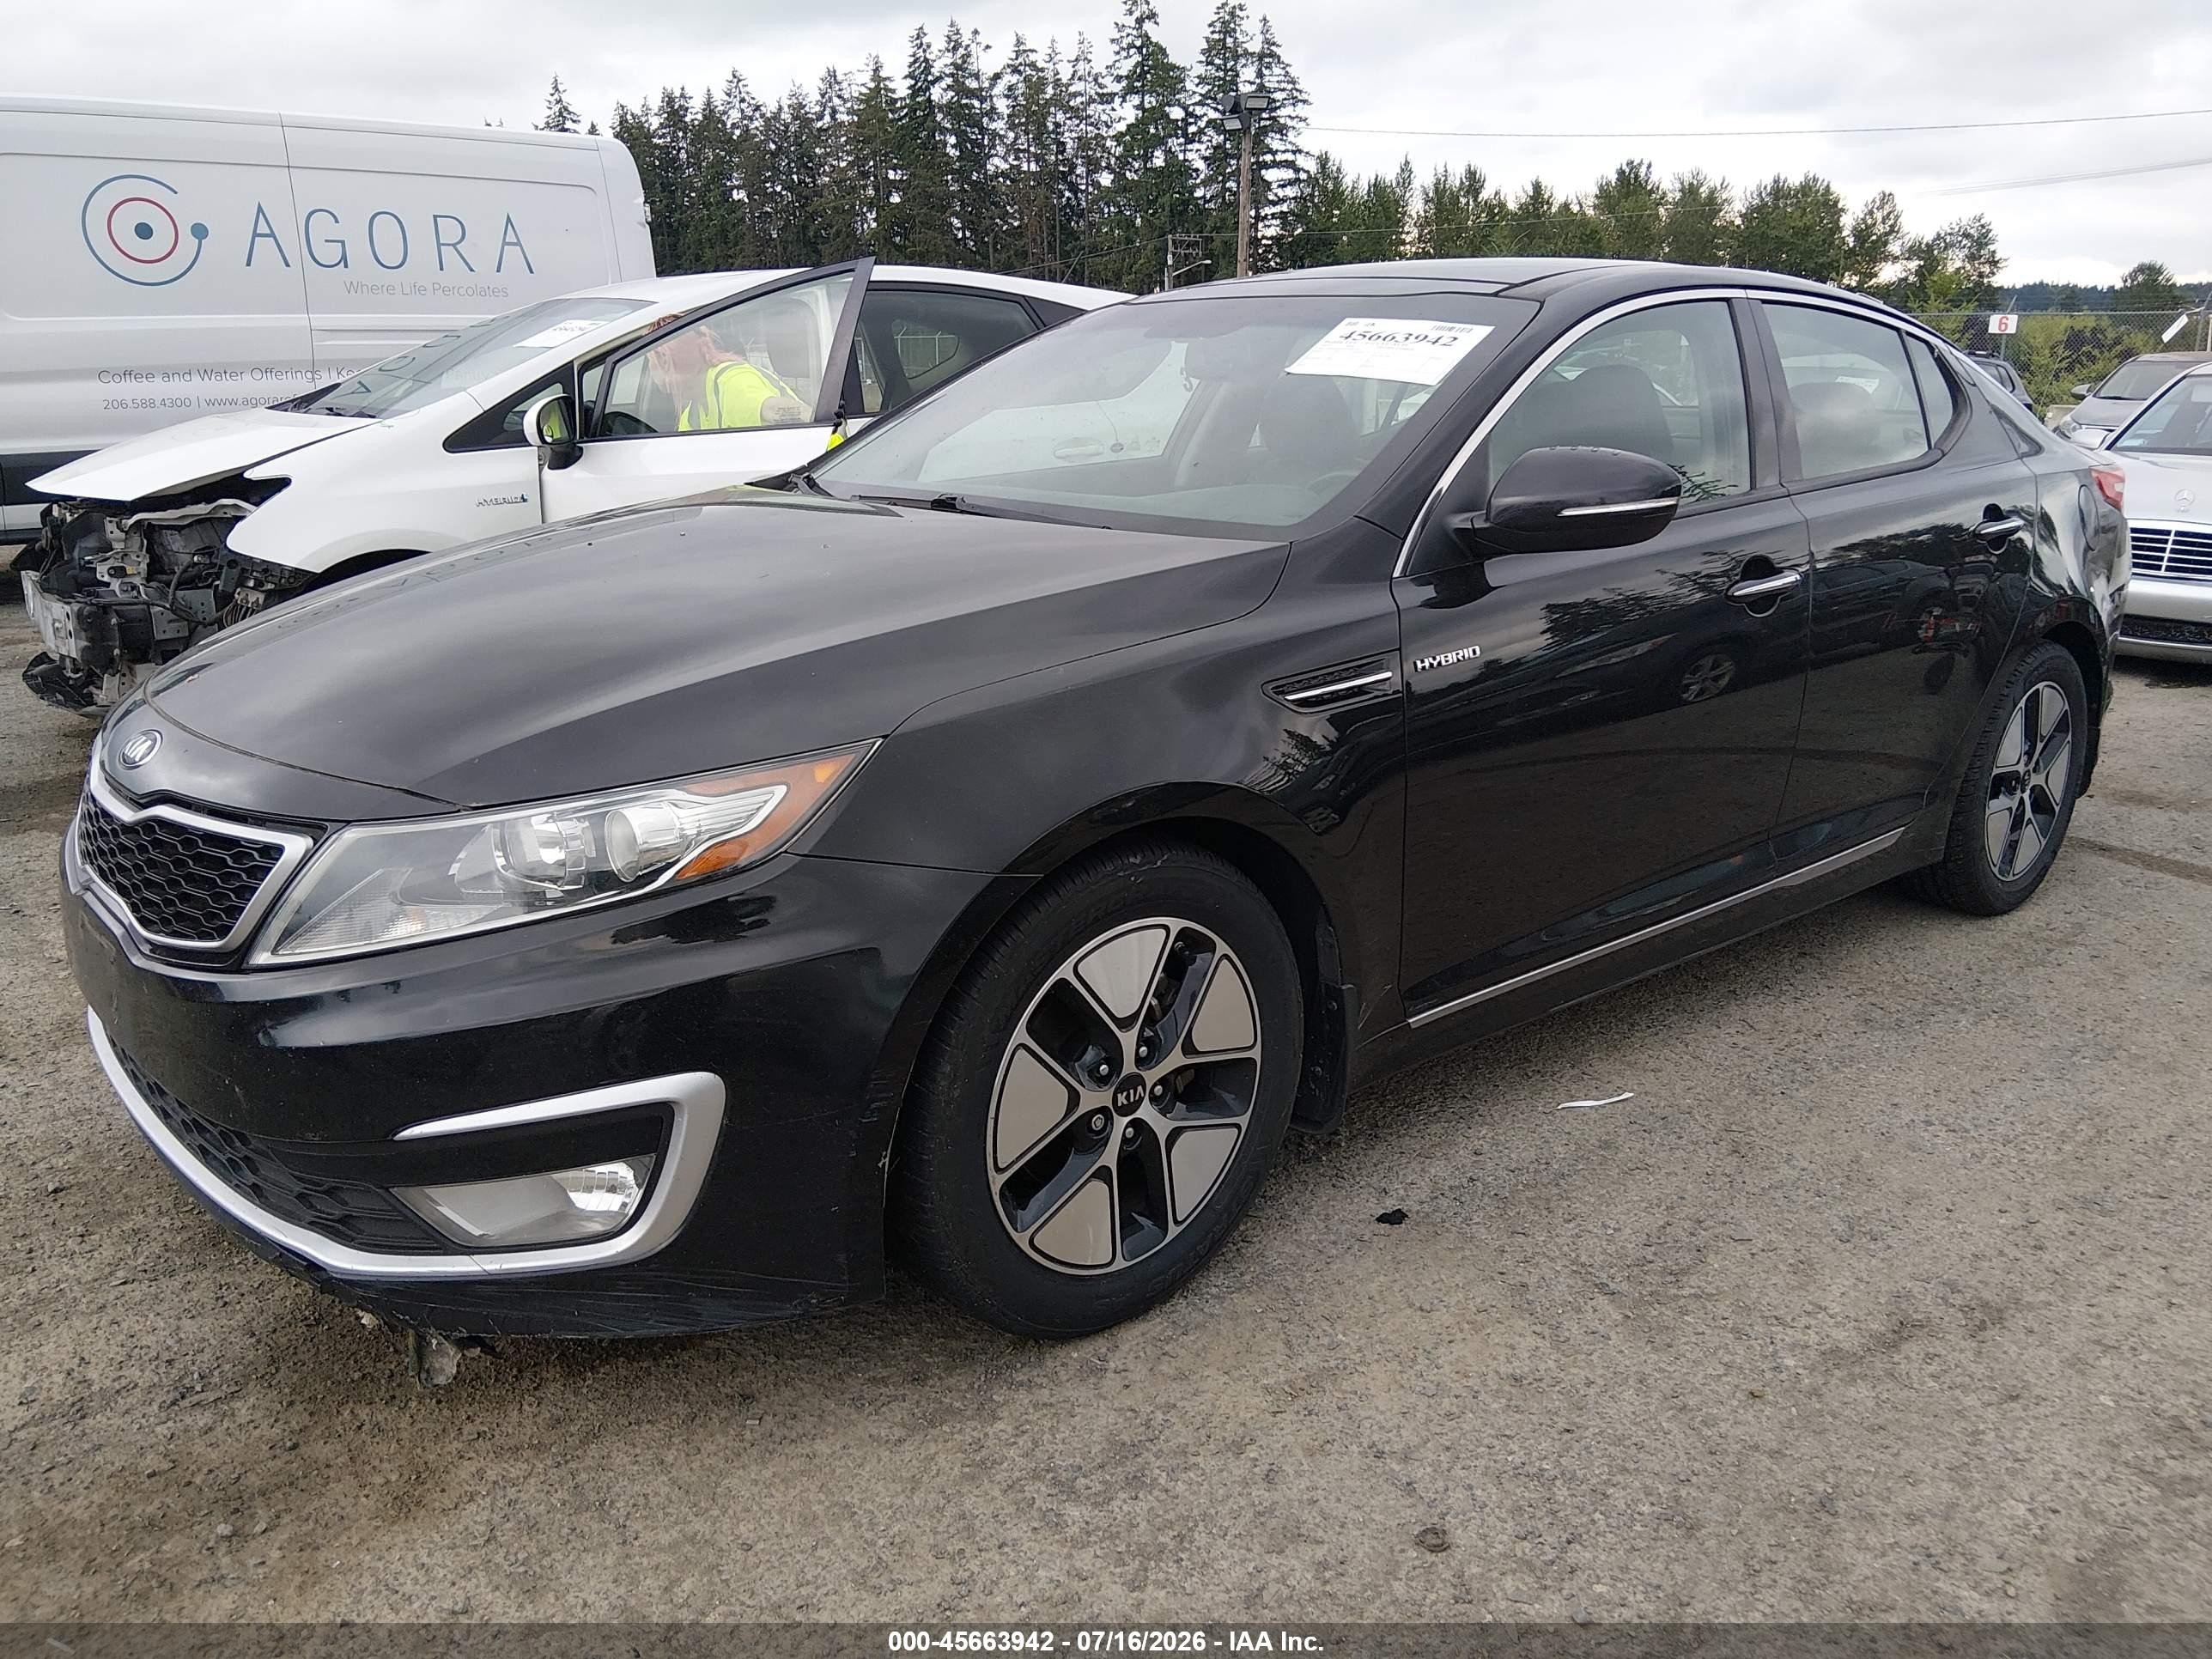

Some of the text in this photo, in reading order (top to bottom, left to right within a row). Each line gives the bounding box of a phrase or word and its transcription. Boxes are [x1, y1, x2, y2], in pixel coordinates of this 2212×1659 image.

[246, 202, 534, 274] AGORA
[343, 281, 509, 298] Where Life Percolates
[1997, 315, 2009, 332] 6
[1340, 330, 1459, 347] 45663942
[98, 369, 155, 384] Coffee
[161, 368, 192, 383] and
[197, 368, 246, 382] Water
[250, 367, 323, 383] Offerings
[102, 397, 192, 410] 206.588.4300
[476, 495, 521, 507] HYBRID
[1414, 645, 1481, 672] HYBRID
[1117, 1085, 1145, 1107] KIA
